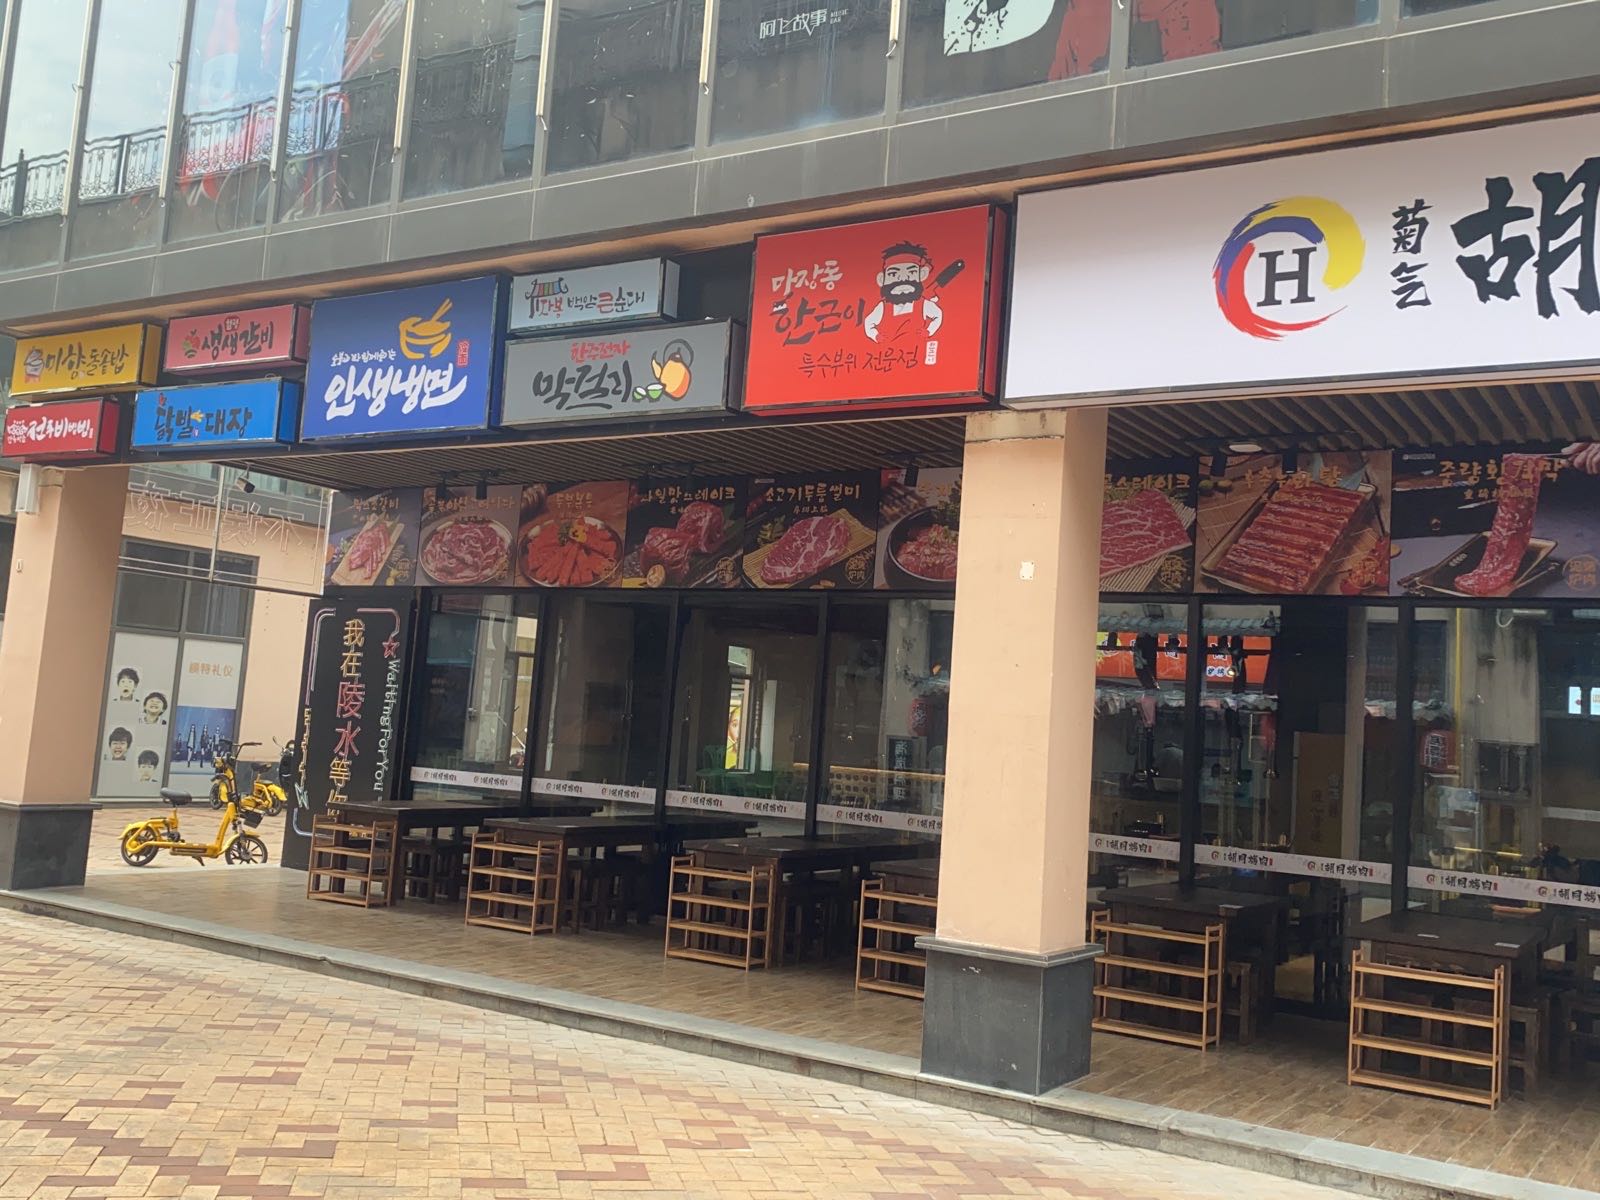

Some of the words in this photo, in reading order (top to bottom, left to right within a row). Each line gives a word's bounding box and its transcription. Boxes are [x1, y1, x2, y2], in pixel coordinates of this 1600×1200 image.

[771, 260, 843, 296] 마장동
[201, 320, 274, 361] 생생갈비
[769, 291, 866, 347] 한근이
[532, 360, 633, 410] 막걸리
[798, 348, 857, 379] 특수부위
[324, 363, 468, 421] 인생냉면
